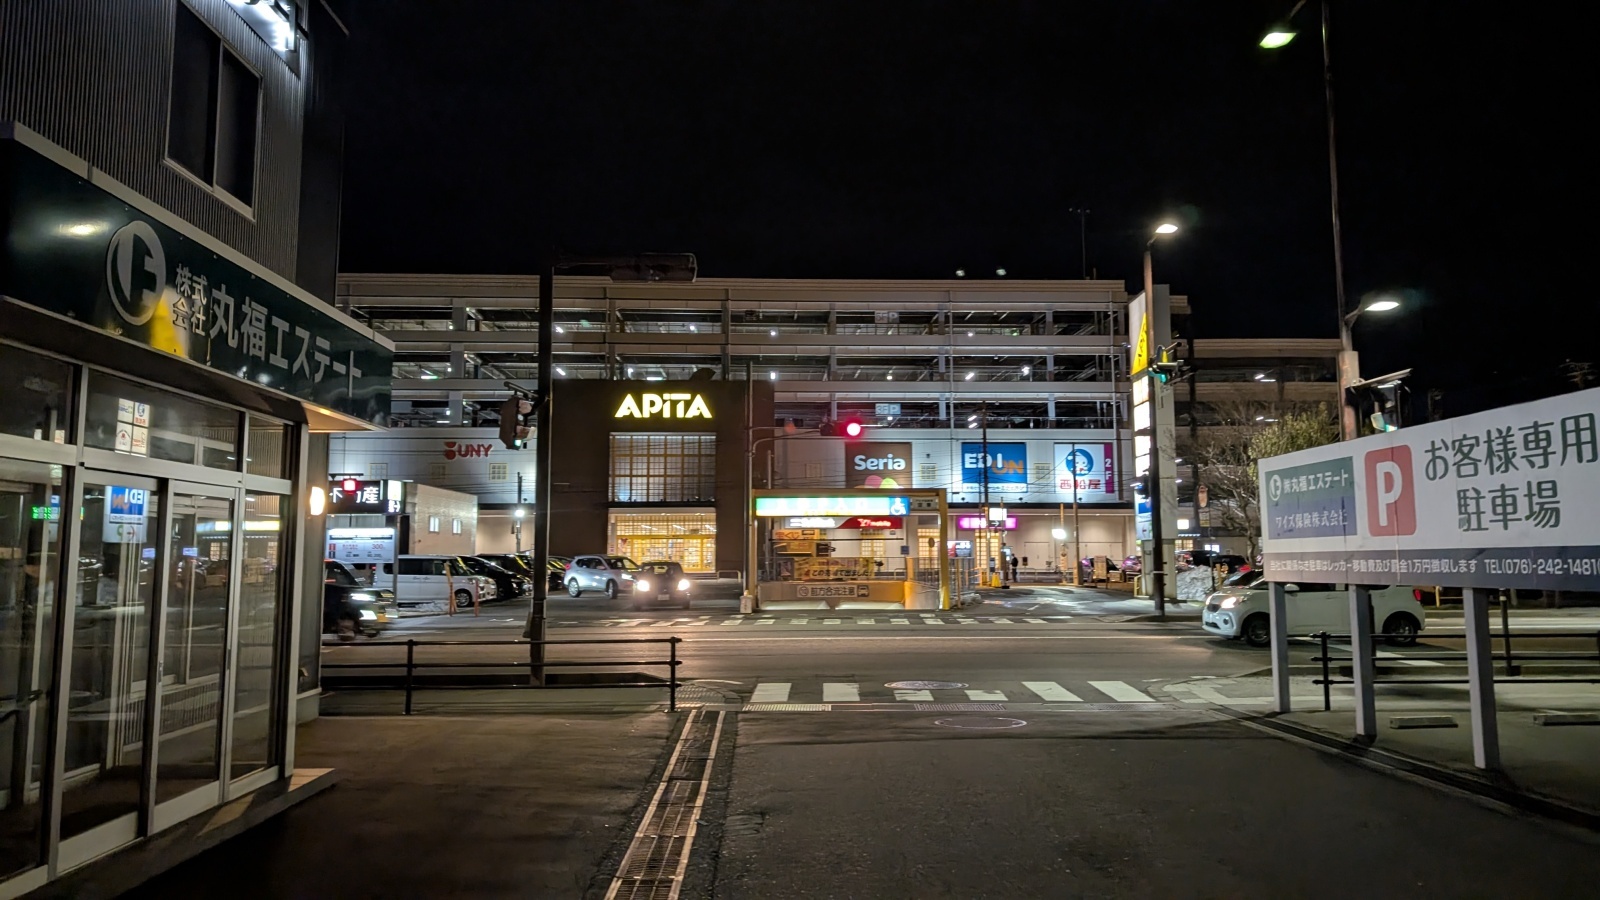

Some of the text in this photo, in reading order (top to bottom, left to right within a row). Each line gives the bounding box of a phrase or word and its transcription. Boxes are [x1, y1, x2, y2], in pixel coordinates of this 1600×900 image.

[175, 263, 208, 306] 株式
[173, 297, 206, 337] 会社
[210, 284, 362, 398] 丸福エステート
[458, 444, 493, 458] UNY
[854, 454, 906, 471] Seria
[1424, 413, 1599, 482] お客様専用
[1060, 479, 1101, 489] 西松屋
[1376, 461, 1403, 527] P
[1457, 480, 1561, 532] 駐車場
